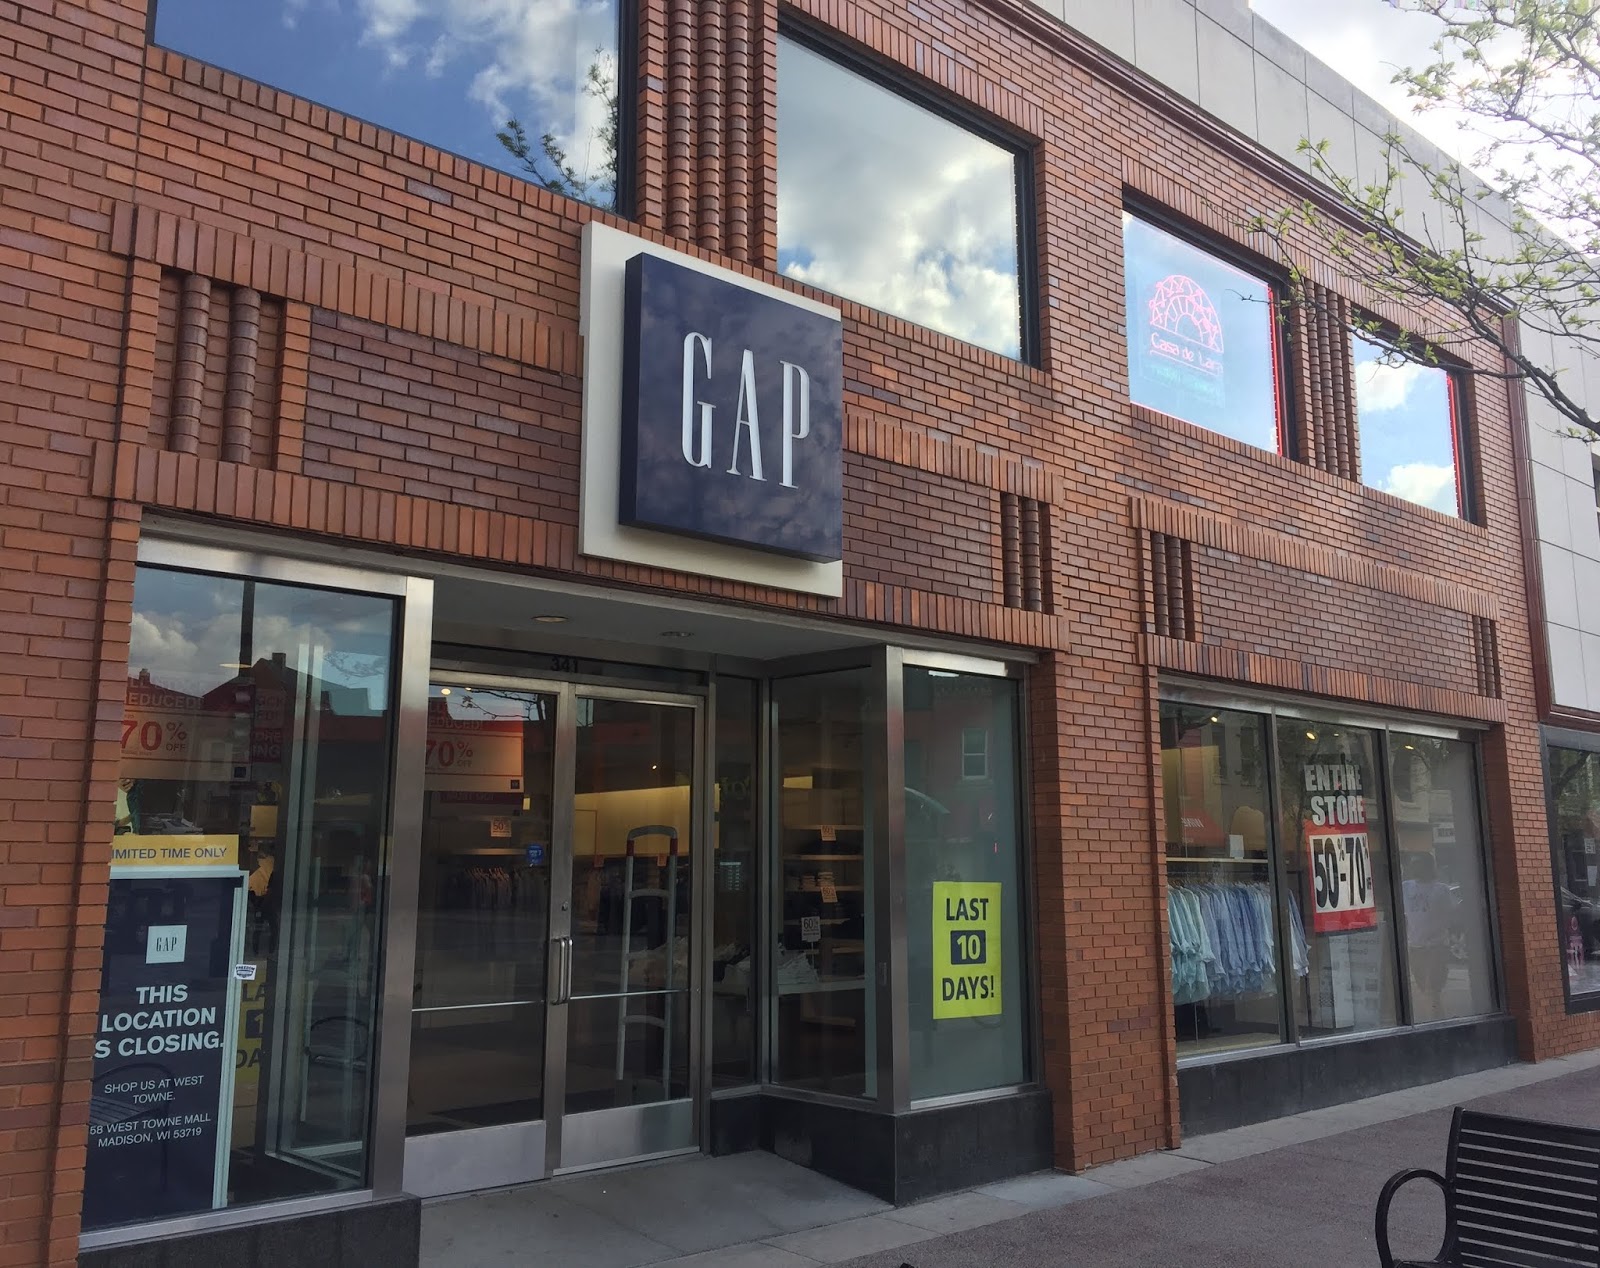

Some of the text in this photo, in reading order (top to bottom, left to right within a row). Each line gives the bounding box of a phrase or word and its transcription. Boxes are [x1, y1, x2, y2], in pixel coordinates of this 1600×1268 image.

[1151, 332, 1180, 356] Casa
[1182, 347, 1194, 362] de
[682, 331, 810, 489] GAP
[551, 655, 578, 673] 341
[128, 692, 202, 709] EDUCED!
[166, 743, 186, 752] OFF
[1304, 764, 1363, 792] ENTIRE
[1310, 795, 1365, 826] STORE
[111, 847, 228, 859] IMITED TIME ONLY
[946, 898, 989, 921] LAST
[156, 937, 177, 952] GAP
[956, 934, 981, 960] 10
[136, 984, 188, 1005] THIS
[942, 975, 995, 1001] DAYS!
[101, 1006, 216, 1033] LOCATION
[94, 1030, 224, 1059] S CLOSING.
[104, 1075, 205, 1094] SHOP US AT WEST
[132, 1091, 176, 1104] TOWNE.
[106, 1121, 139, 1134] WEST
[141, 1116, 182, 1129] TOWNE
[184, 1112, 211, 1125] MALL
[98, 1127, 202, 1148] MADISON, WI 53719
